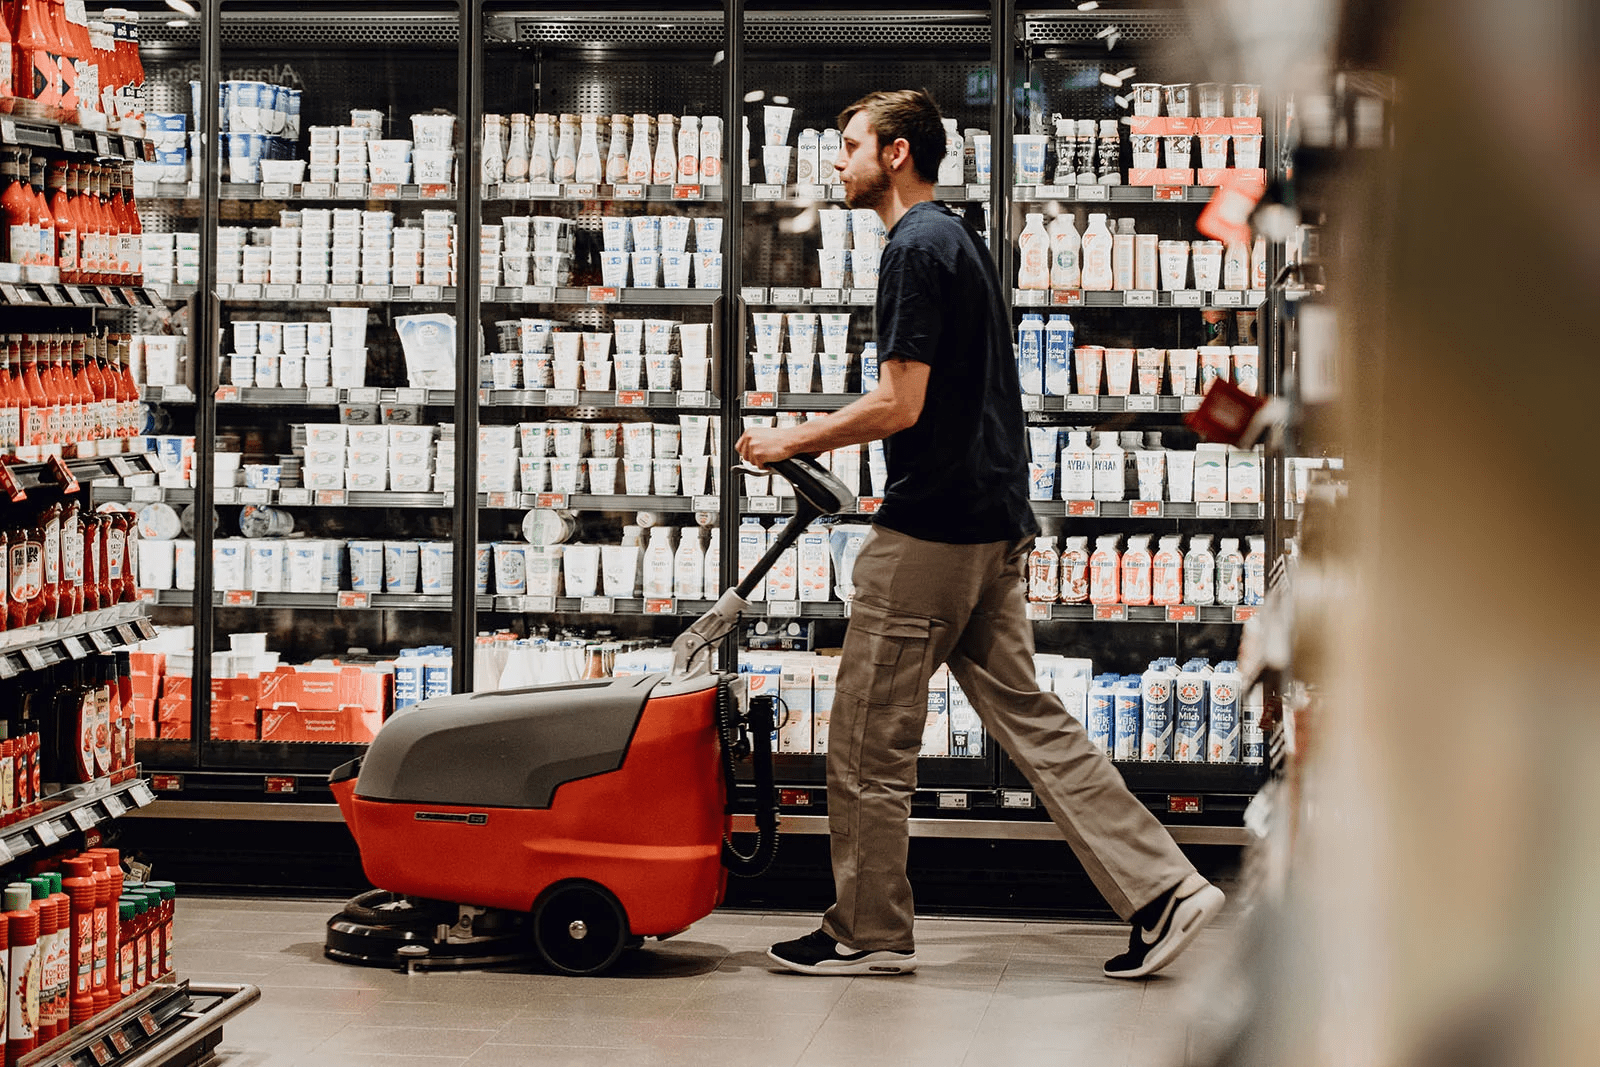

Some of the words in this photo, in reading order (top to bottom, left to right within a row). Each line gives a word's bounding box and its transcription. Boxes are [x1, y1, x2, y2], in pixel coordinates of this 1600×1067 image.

[800, 143, 817, 152] alpro
[821, 143, 838, 152] alpro
[1067, 459, 1091, 471] AYRAN
[1094, 459, 1117, 471] AYRAN
[1145, 711, 1167, 721] Milch
[1178, 711, 1200, 722] Milch
[1212, 712, 1233, 722] Milch
